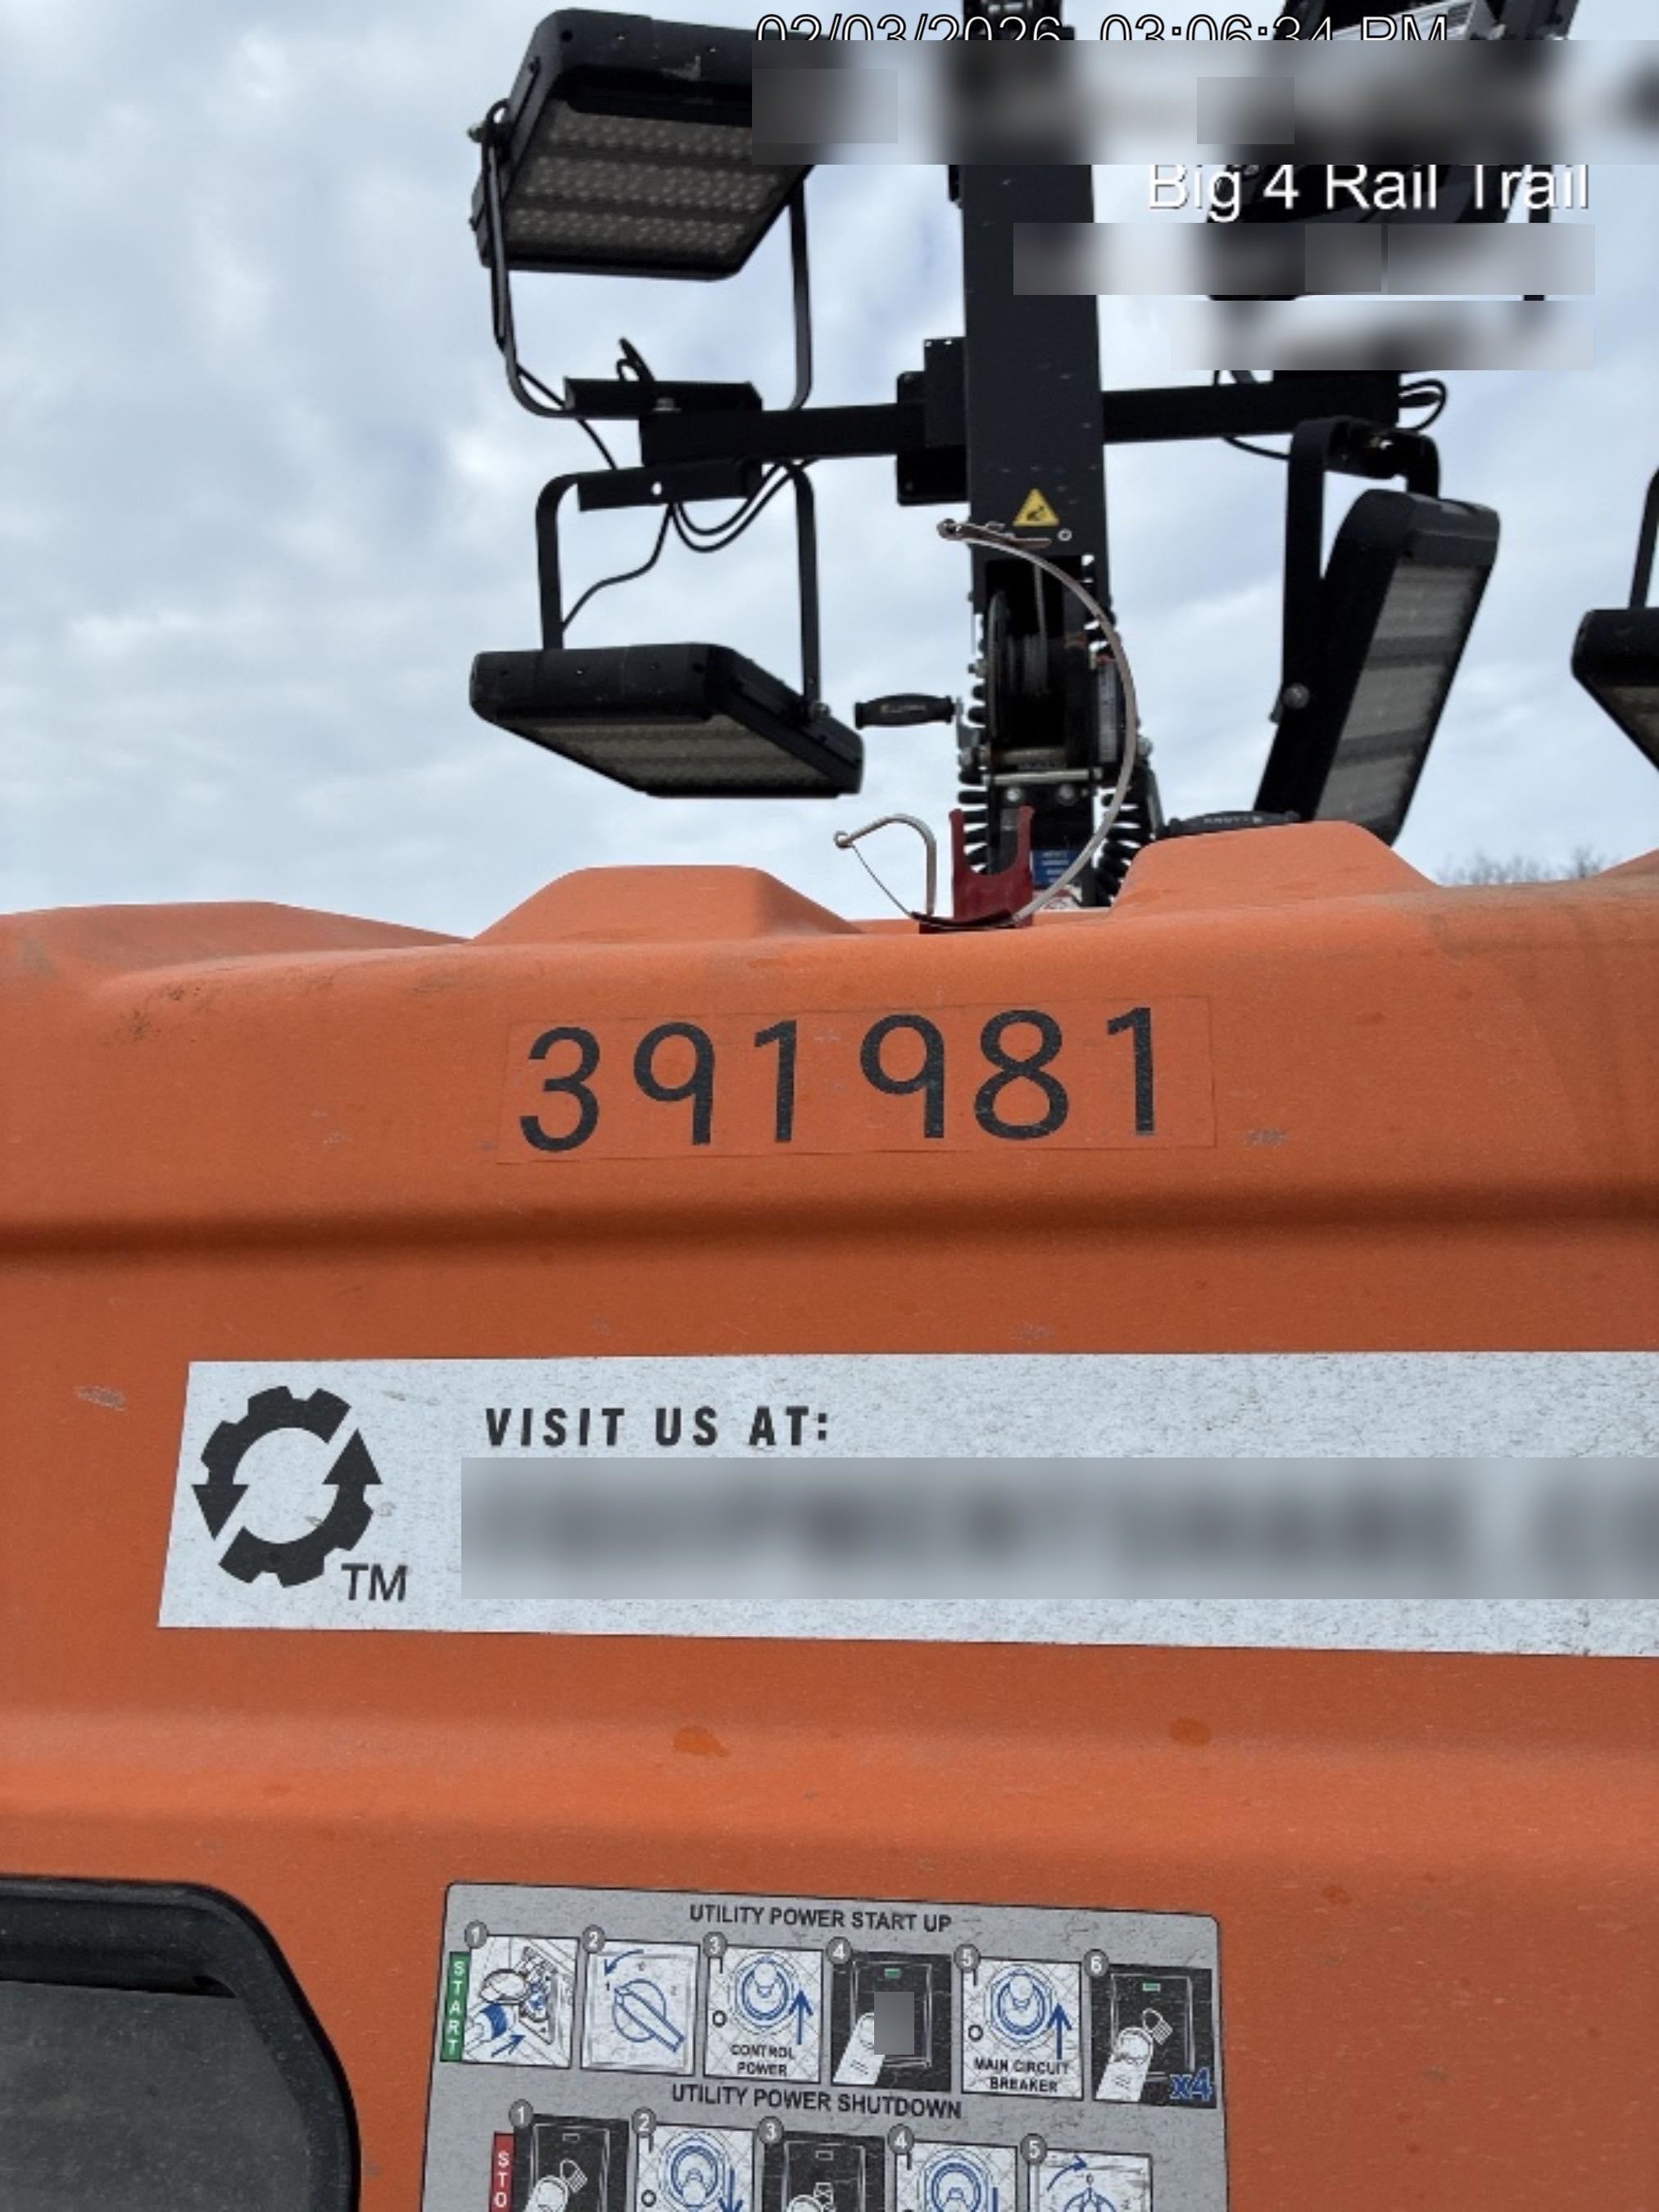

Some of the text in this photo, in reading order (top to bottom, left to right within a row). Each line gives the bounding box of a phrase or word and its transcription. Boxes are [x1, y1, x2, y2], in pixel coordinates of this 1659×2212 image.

[486, 1406, 829, 1446] VISIT US AT:
[342, 1564, 407, 1601] TM
[690, 1904, 952, 1932] UTILITY POWER START UP
[470, 1928, 481, 1942] 1
[588, 1931, 599, 1949] 2
[709, 1938, 720, 1955] 3
[832, 1942, 846, 1959] 4
[961, 1950, 972, 1967] 5
[1090, 1957, 1102, 1973] 6
[446, 1961, 465, 2056] START
[732, 2044, 796, 2060] CONTROL
[737, 2061, 788, 2076] POWER
[974, 2057, 1067, 2075] MAIN CIRCUIT
[990, 2077, 1058, 2092] BREAKER
[673, 2083, 962, 2119] UTILITY POWER SHUTDOWN
[517, 2106, 526, 2124] 1
[638, 2114, 650, 2131] 2
[765, 2123, 777, 2139] 3
[894, 2131, 907, 2149] 4
[1028, 2140, 1040, 2159] 5
